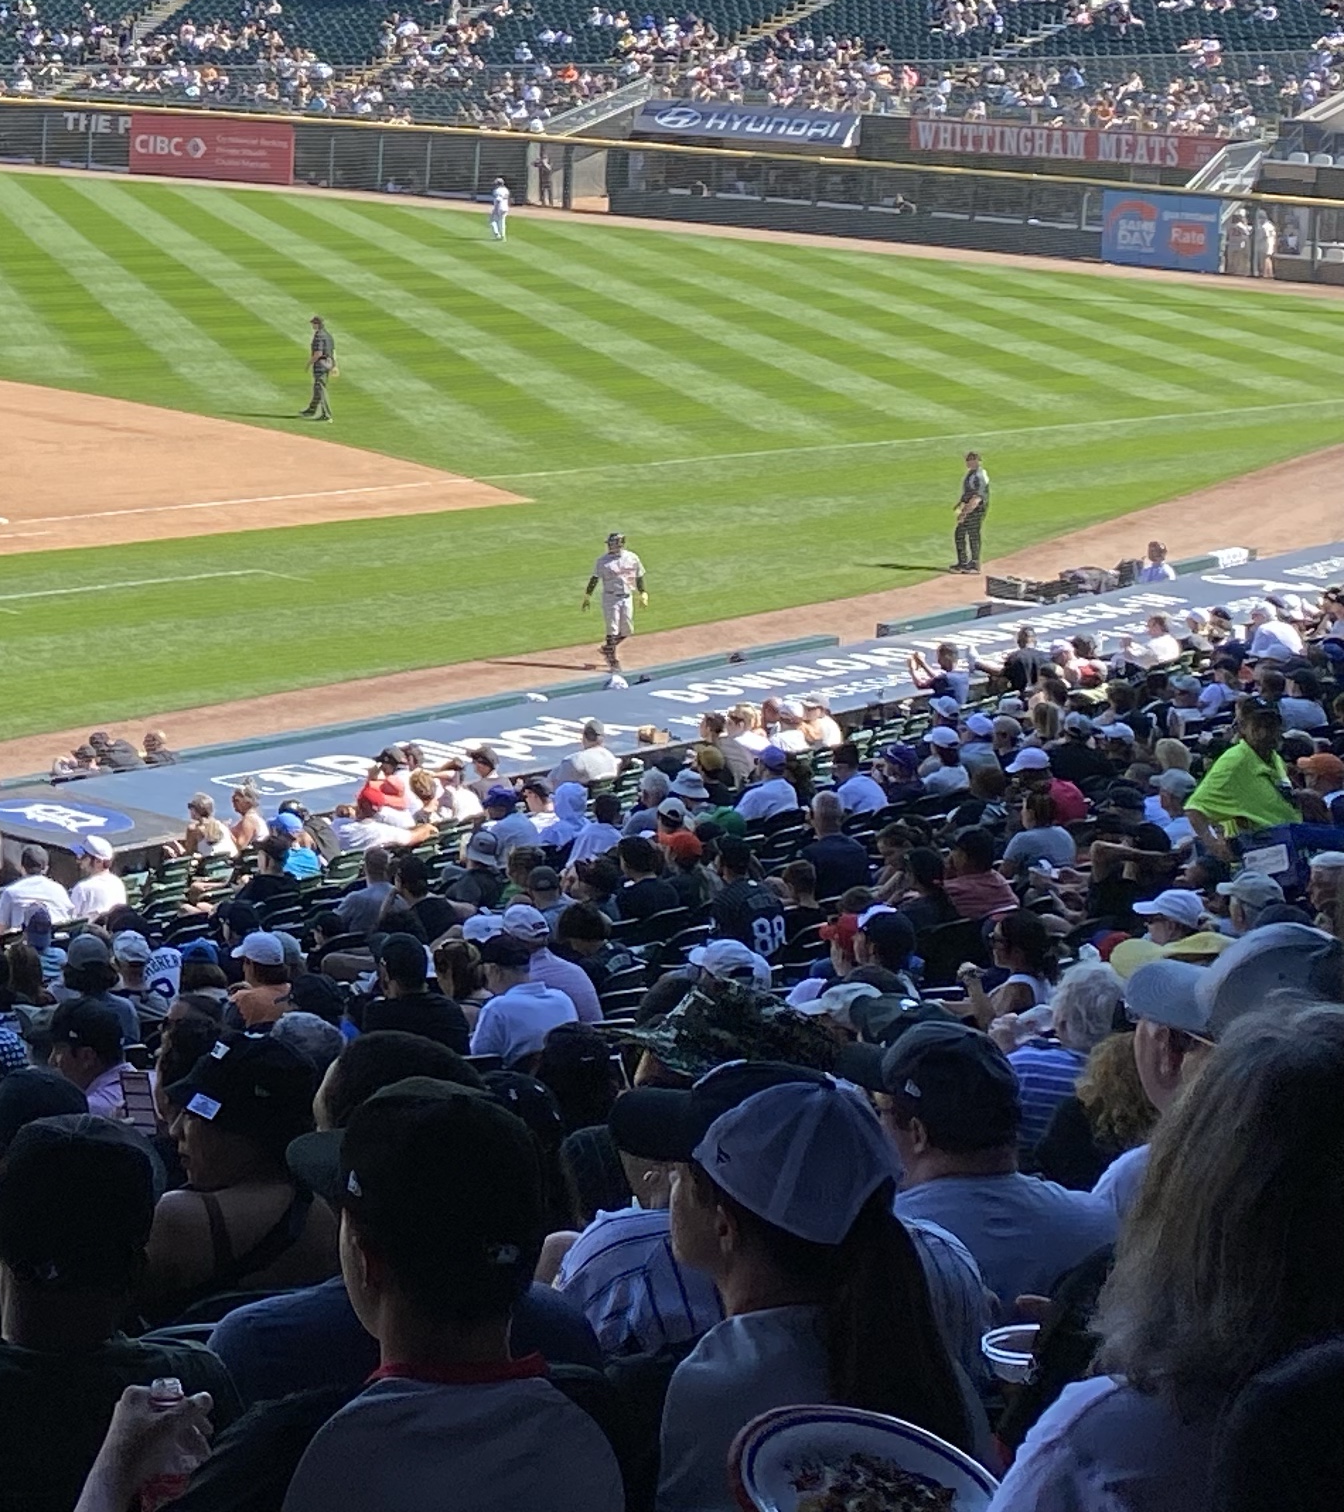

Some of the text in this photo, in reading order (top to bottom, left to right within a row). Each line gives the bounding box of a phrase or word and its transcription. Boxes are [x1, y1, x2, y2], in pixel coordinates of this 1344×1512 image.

[64, 112, 112, 133] THE
[706, 113, 840, 137] HYUNDAI
[135, 135, 183, 156] CIBC
[917, 121, 1086, 158] WHITTINGHAM
[1098, 133, 1179, 167] MEATS
[1118, 232, 1155, 247] DAY
[1171, 227, 1205, 245] Rate
[649, 646, 920, 704] DOWNLOAD
[306, 715, 640, 778] Bllpark
